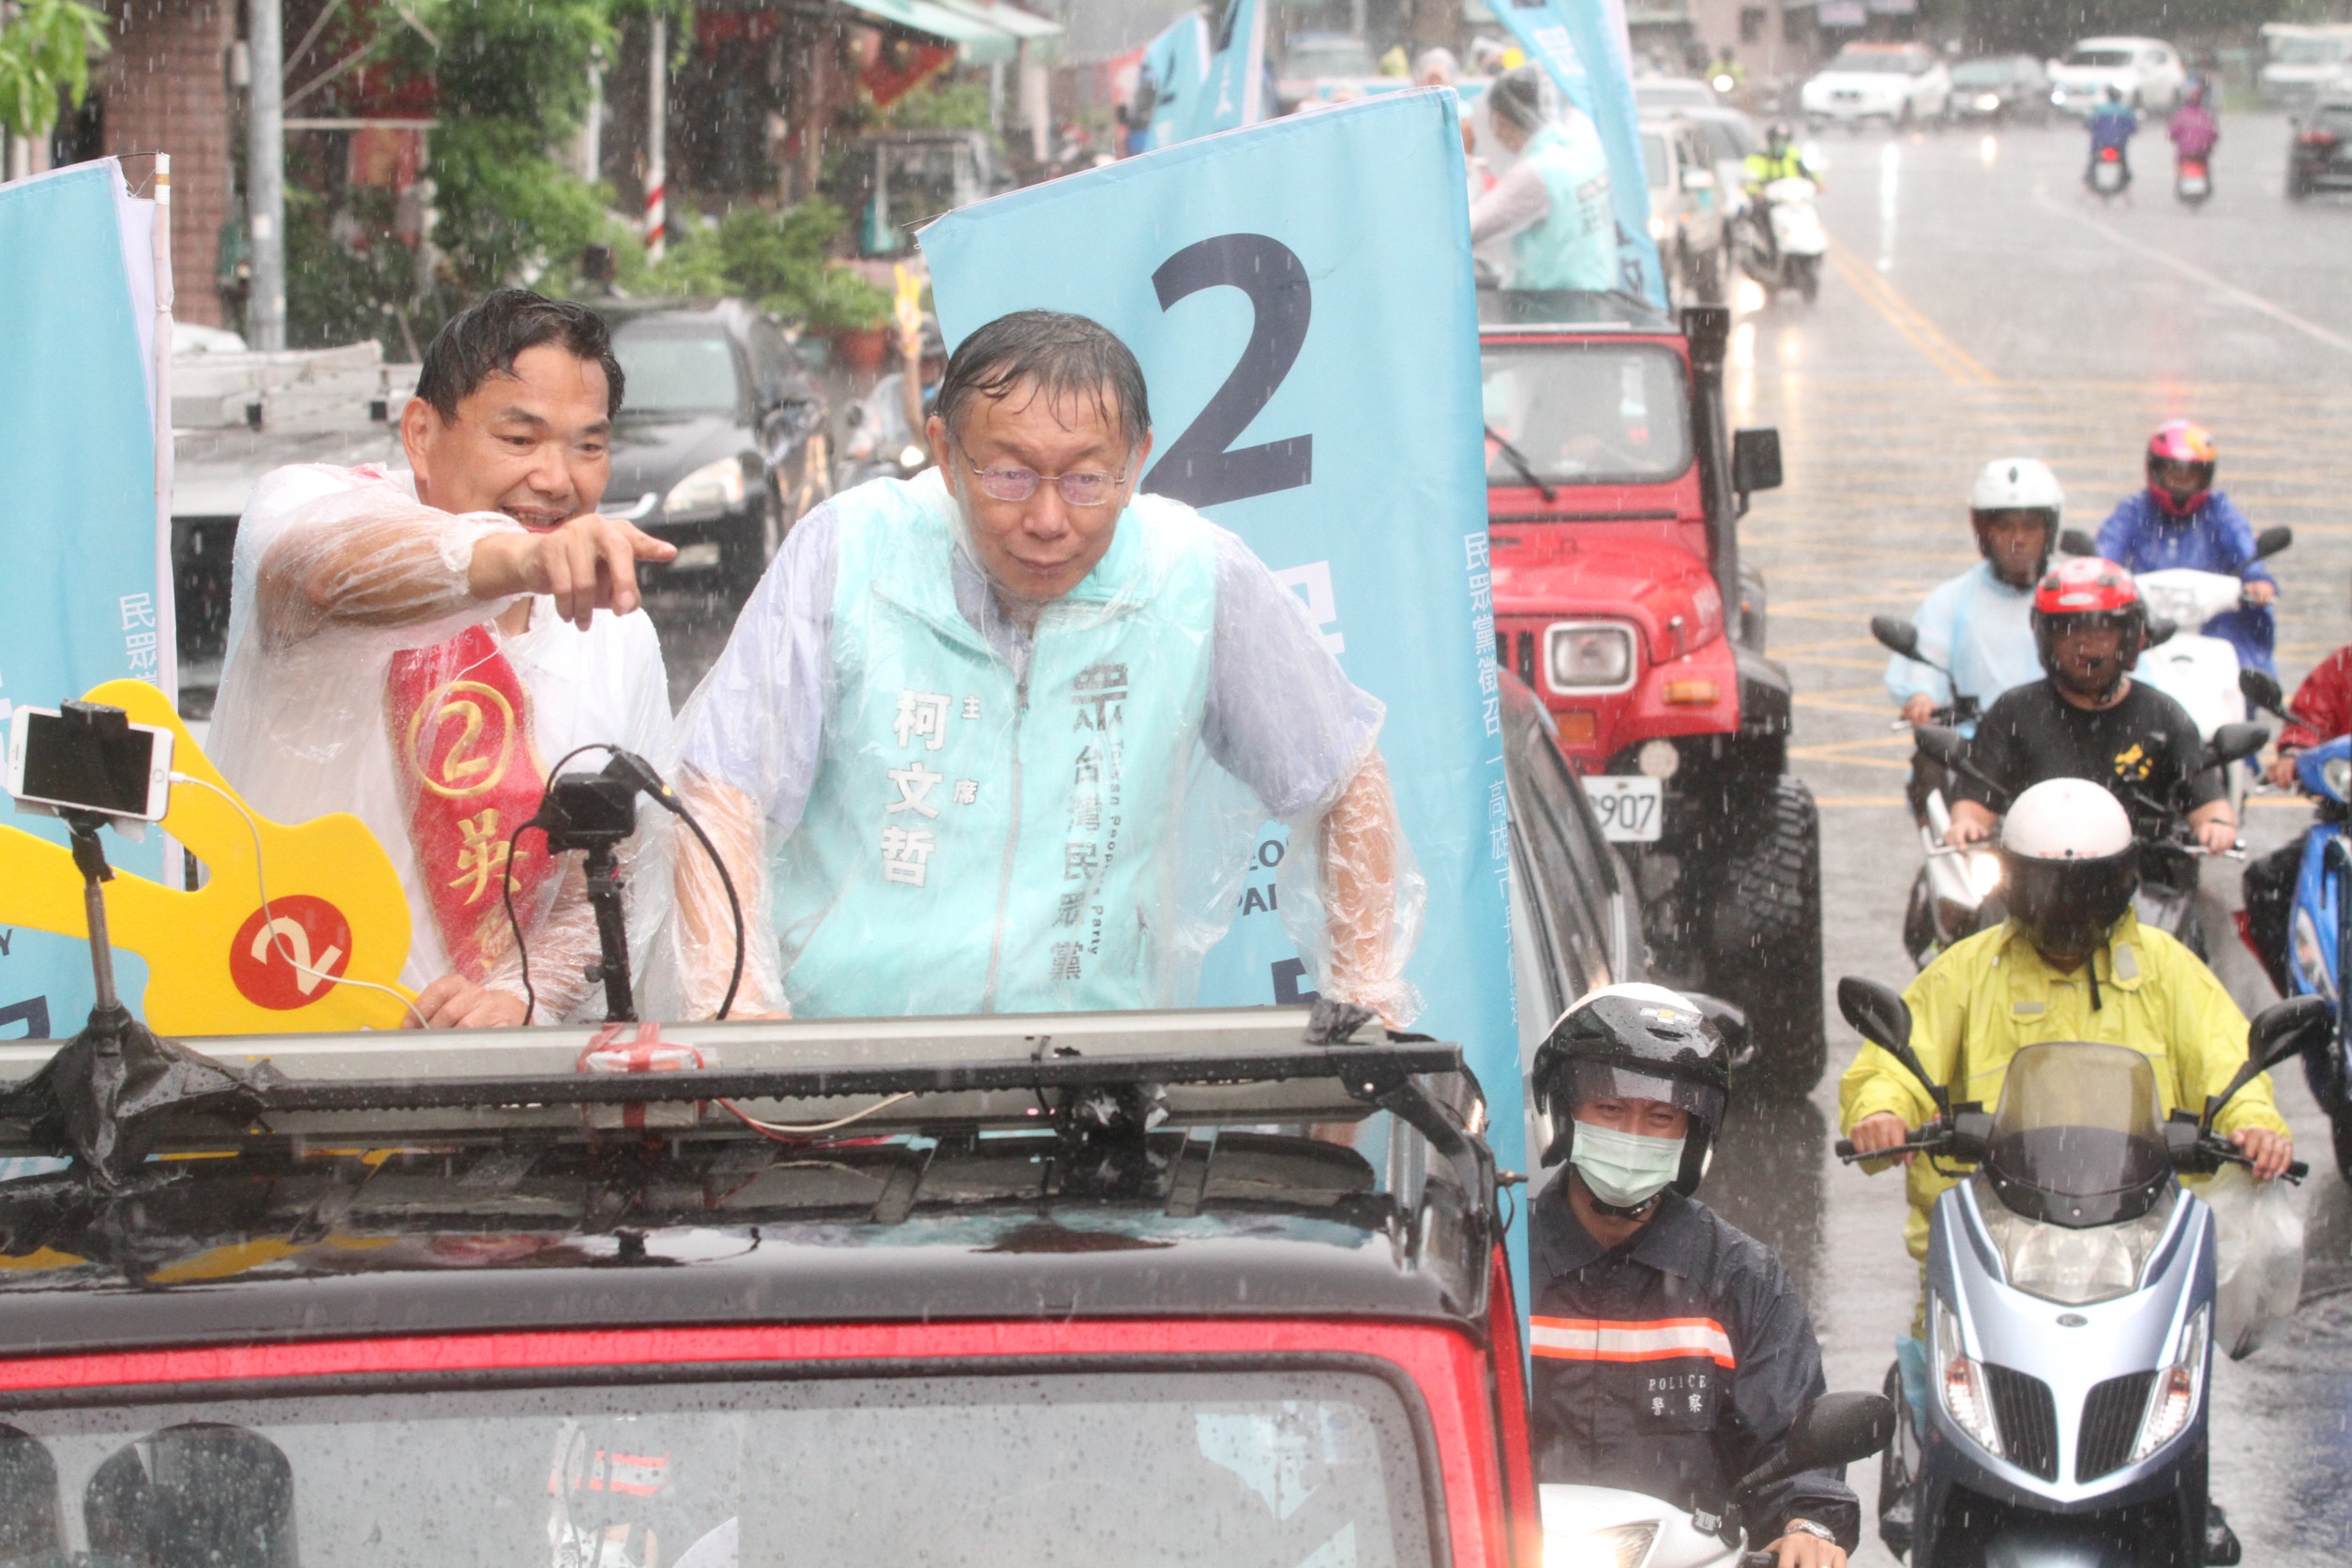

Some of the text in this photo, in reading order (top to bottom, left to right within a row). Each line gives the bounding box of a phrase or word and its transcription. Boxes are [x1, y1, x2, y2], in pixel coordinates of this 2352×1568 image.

[1140, 233, 1313, 508] 2
[880, 687, 952, 889] 柯文哲
[952, 693, 981, 806] 主席
[250, 916, 343, 996] 2
[1088, 905, 1104, 955] Party
[1649, 1374, 1707, 1392] POLICE
[1651, 1394, 1703, 1416] 警察
